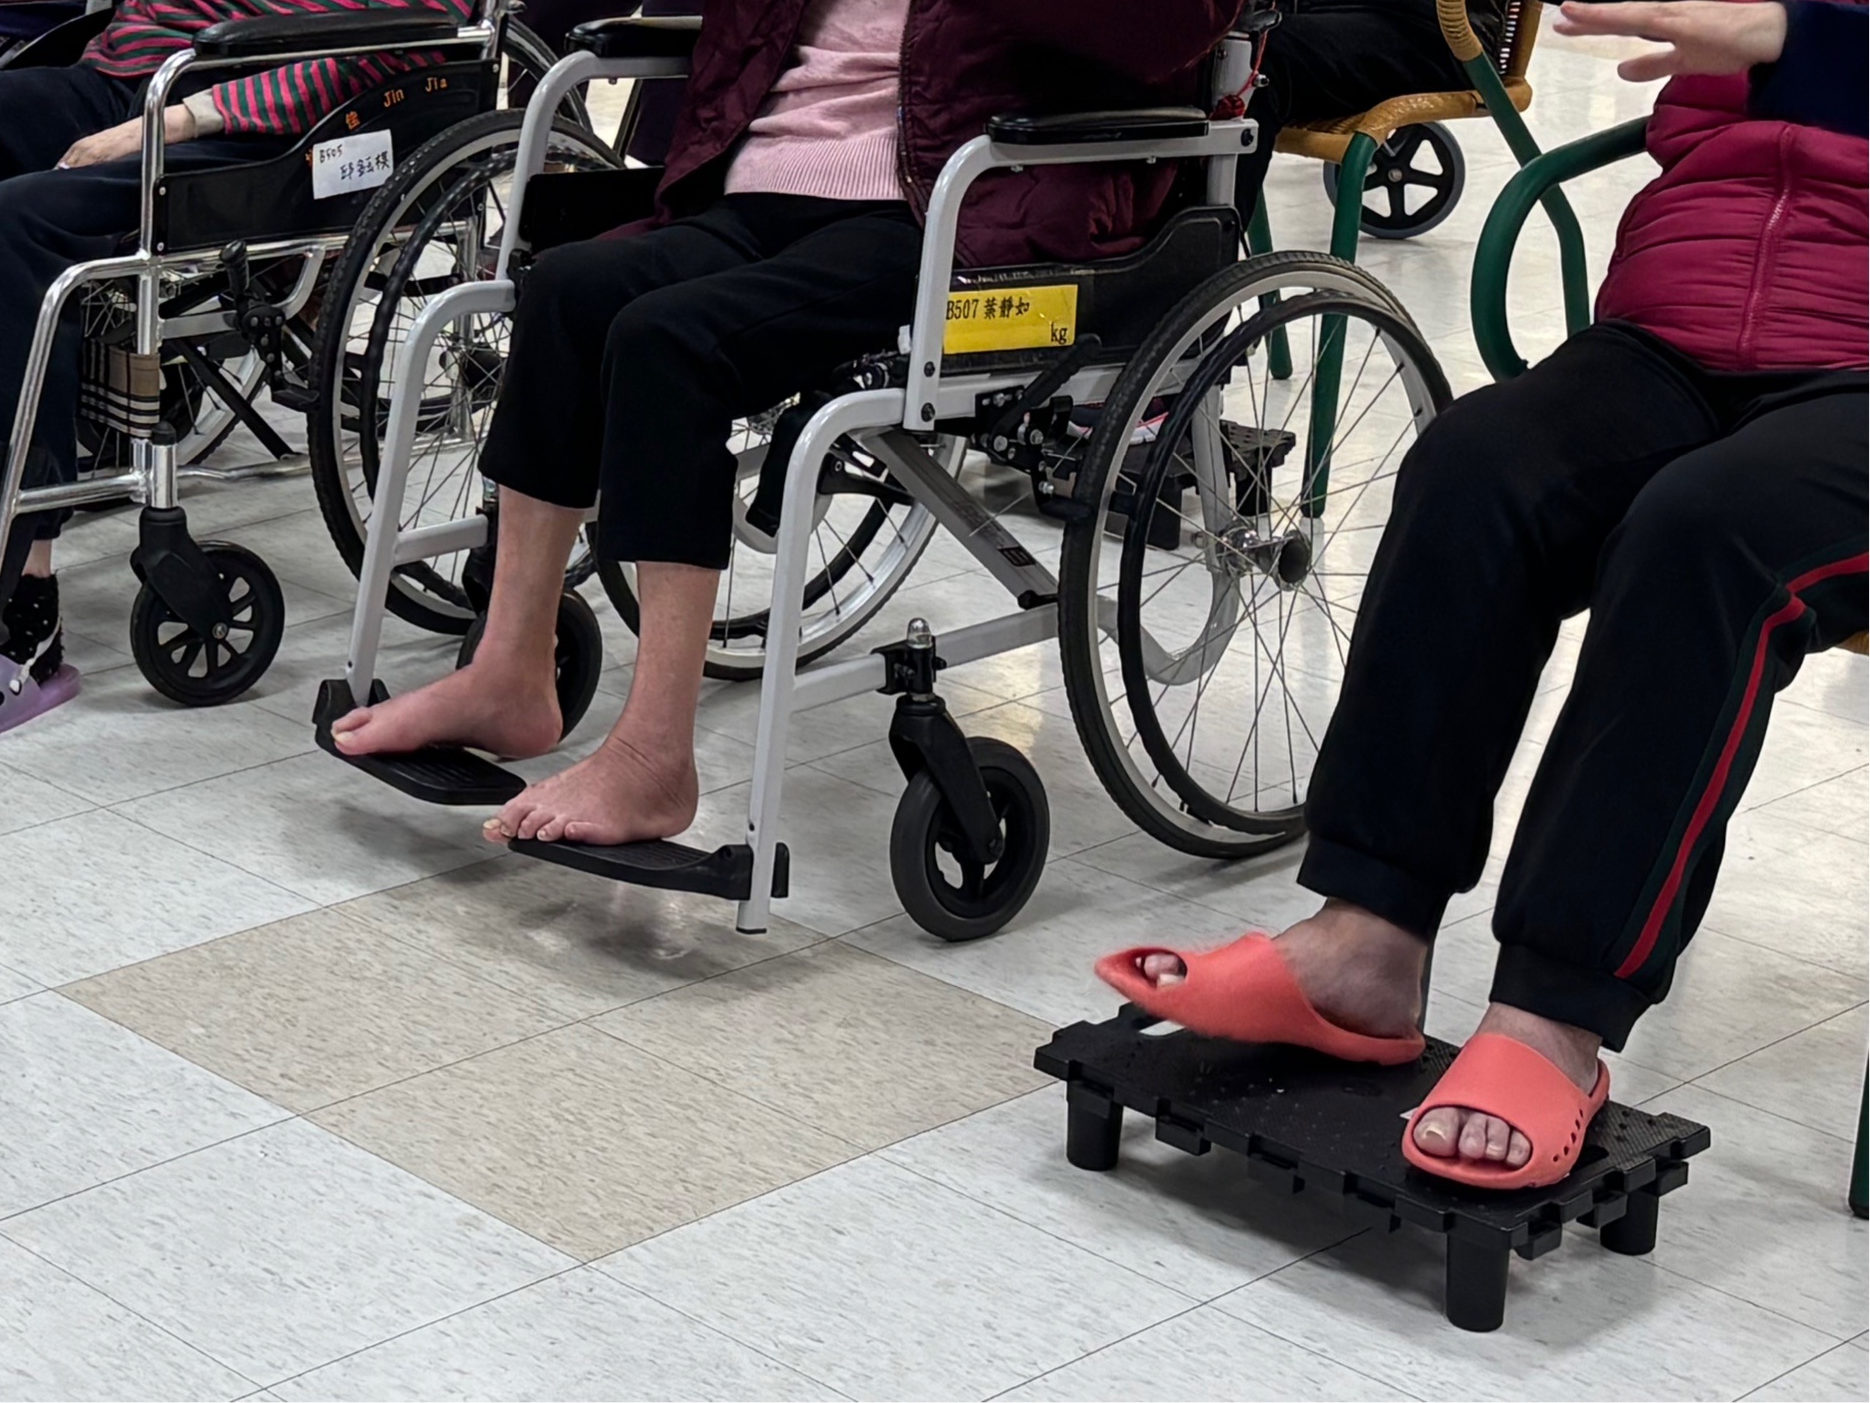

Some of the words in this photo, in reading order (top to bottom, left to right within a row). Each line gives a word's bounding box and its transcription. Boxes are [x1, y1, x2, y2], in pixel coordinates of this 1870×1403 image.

[383, 89, 405, 108] Jin
[425, 77, 448, 92] Jia
[945, 298, 979, 320] B507
[1050, 322, 1068, 344] kg
